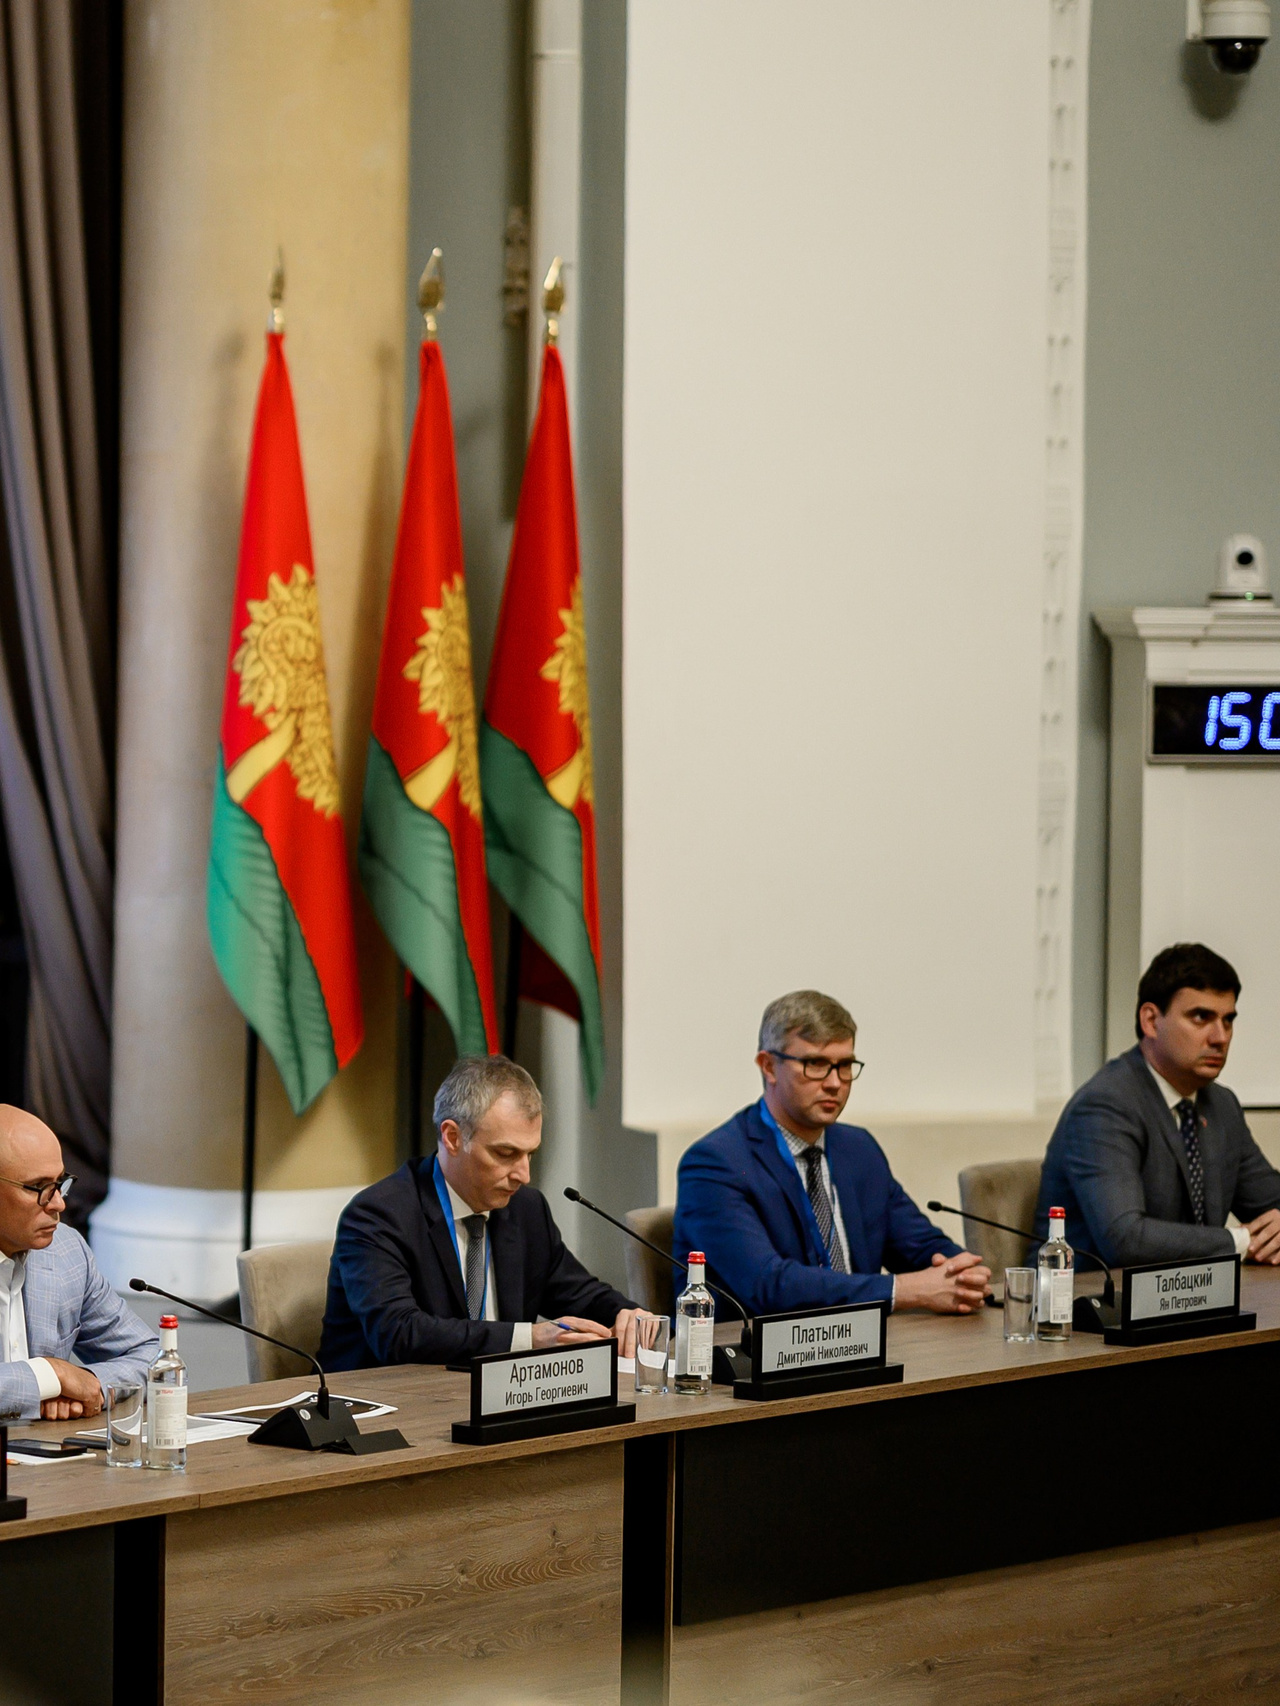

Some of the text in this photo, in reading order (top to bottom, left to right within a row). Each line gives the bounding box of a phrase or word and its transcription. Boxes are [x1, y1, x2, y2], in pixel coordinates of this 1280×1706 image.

[1155, 1267, 1213, 1293] Талбацкий
[1160, 1294, 1207, 1310] Ян Петрович
[791, 1323, 852, 1345] Платыгин
[777, 1343, 868, 1368] Дмитрий Николаевич
[510, 1358, 584, 1387] Артамонов
[505, 1383, 588, 1407] Игорь Георгиевич
